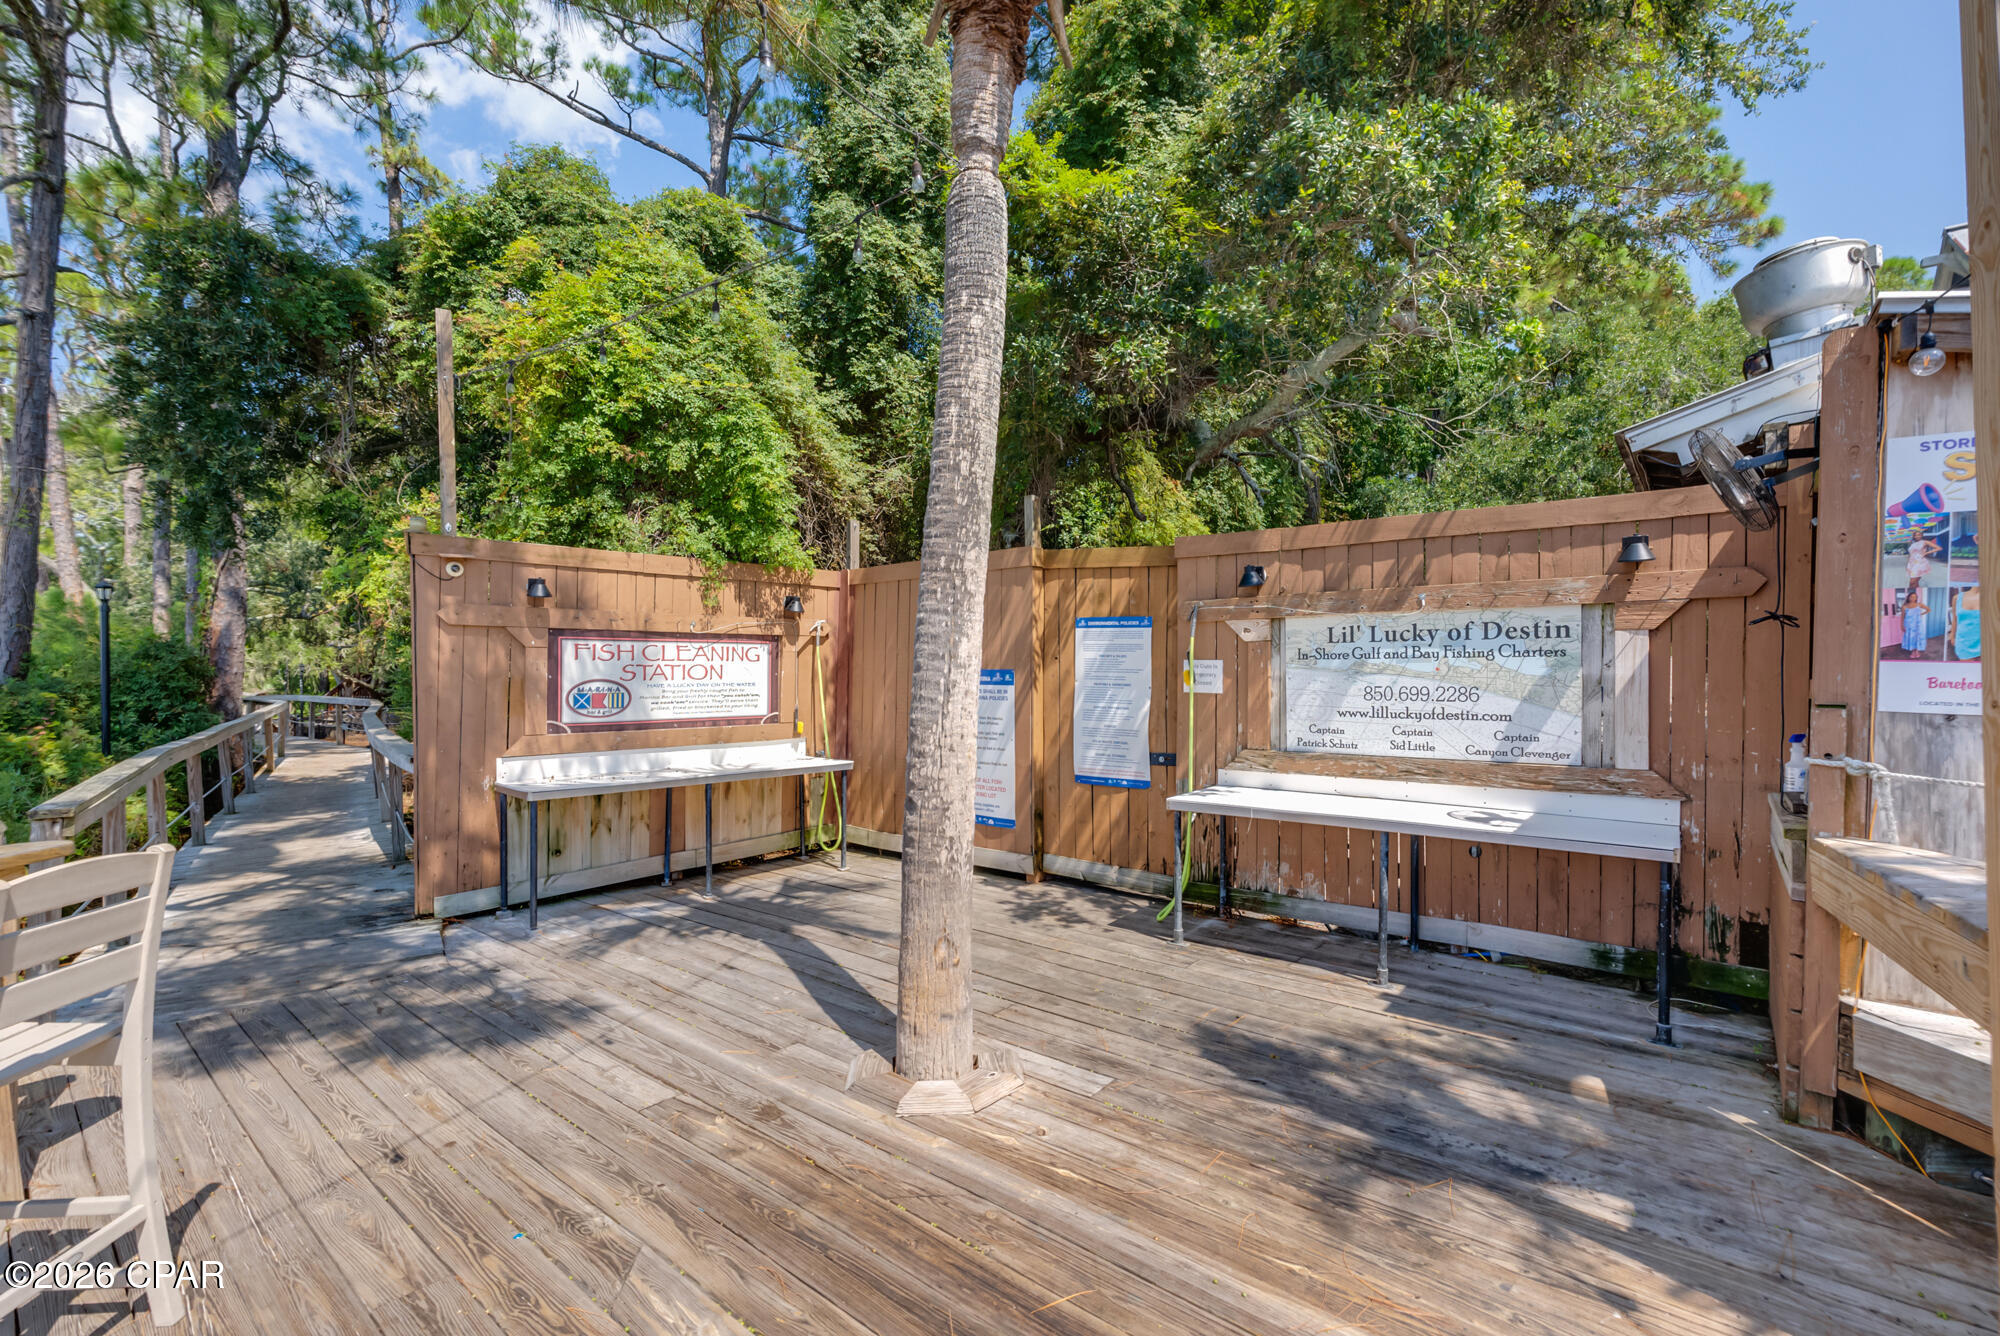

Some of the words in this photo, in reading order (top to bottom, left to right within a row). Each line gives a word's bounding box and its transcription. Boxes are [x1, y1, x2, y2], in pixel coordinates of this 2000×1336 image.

[1327, 625, 1360, 643] Lil'
[1368, 623, 1440, 647] Lucky
[1447, 621, 1474, 641] of
[1481, 620, 1571, 640] Destin
[574, 643, 635, 661] FISH
[642, 644, 761, 662] CLEANING
[1297, 647, 1350, 660] In-Shore
[1351, 646, 1381, 660] Gulf
[1383, 646, 1408, 659] and
[1411, 645, 1439, 661] Bay
[1443, 645, 1495, 661] Fishing
[1498, 643, 1567, 658] Charters
[619, 664, 723, 681] STATION
[1363, 685, 1480, 702] 850.699.2286
[1337, 705, 1512, 722] www.lilluckyofdestin.com
[1309, 724, 1345, 735] Captain
[1392, 726, 1433, 738] Captain
[1493, 730, 1540, 743] Captain
[1297, 737, 1328, 748] Patrick
[1329, 739, 1358, 749] Schutz
[1390, 740, 1406, 751] Sid
[1407, 741, 1436, 752] Little
[1465, 744, 1508, 758] Canyon
[1510, 746, 1571, 761] Clevenger
